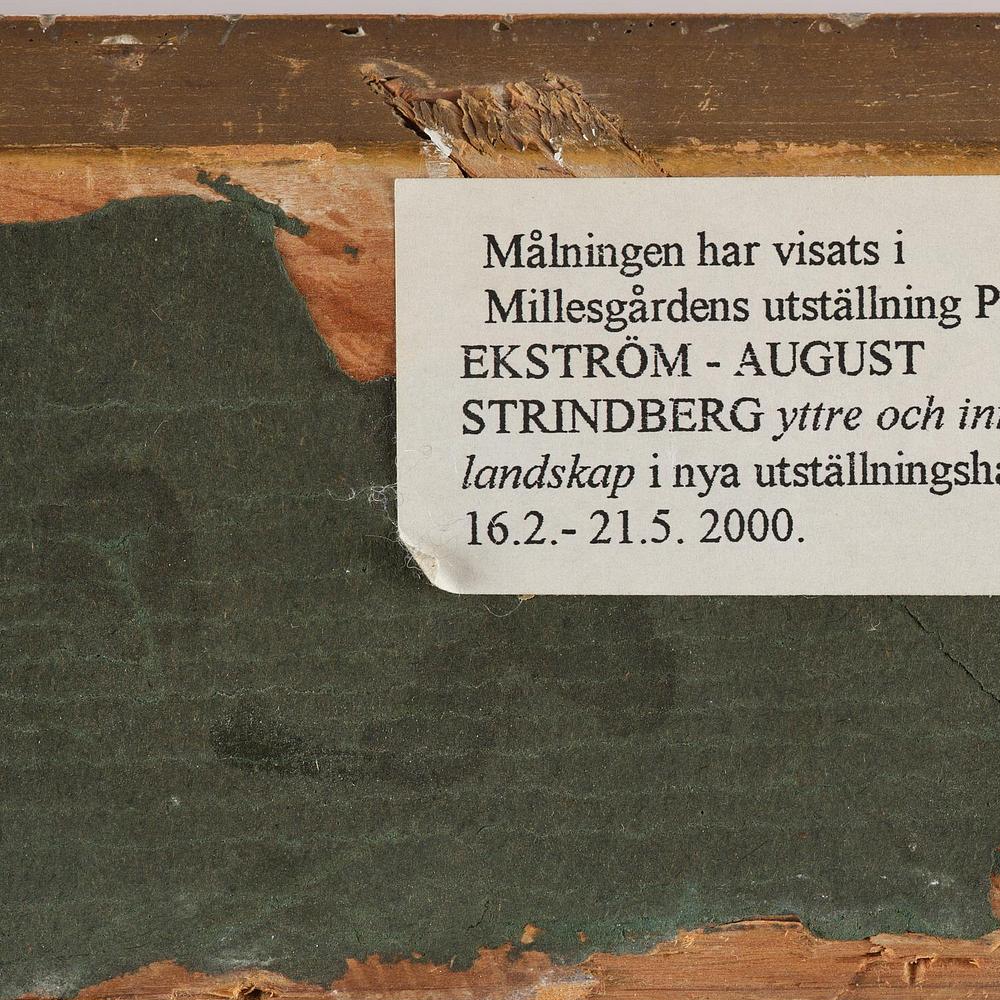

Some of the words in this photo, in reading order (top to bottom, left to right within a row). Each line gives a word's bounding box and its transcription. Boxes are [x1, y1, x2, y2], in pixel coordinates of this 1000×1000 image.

[482, 229, 685, 277] Målningen
[698, 230, 761, 268] har
[771, 230, 880, 267] visats
[893, 229, 906, 265] i
[484, 284, 750, 333] Millesgårdens
[762, 284, 962, 330] utställning
[460, 335, 692, 380] EKSTRÖM
[733, 339, 925, 378] AUGUST
[461, 396, 765, 435] STRINDBERG
[771, 400, 863, 442] yttre
[876, 394, 945, 431] och
[461, 453, 636, 499] landskap
[648, 452, 662, 489] i
[672, 463, 741, 498] nya
[466, 509, 577, 546] 16.2.-
[589, 508, 684, 545] 21.5.
[699, 507, 805, 544] 2000.
